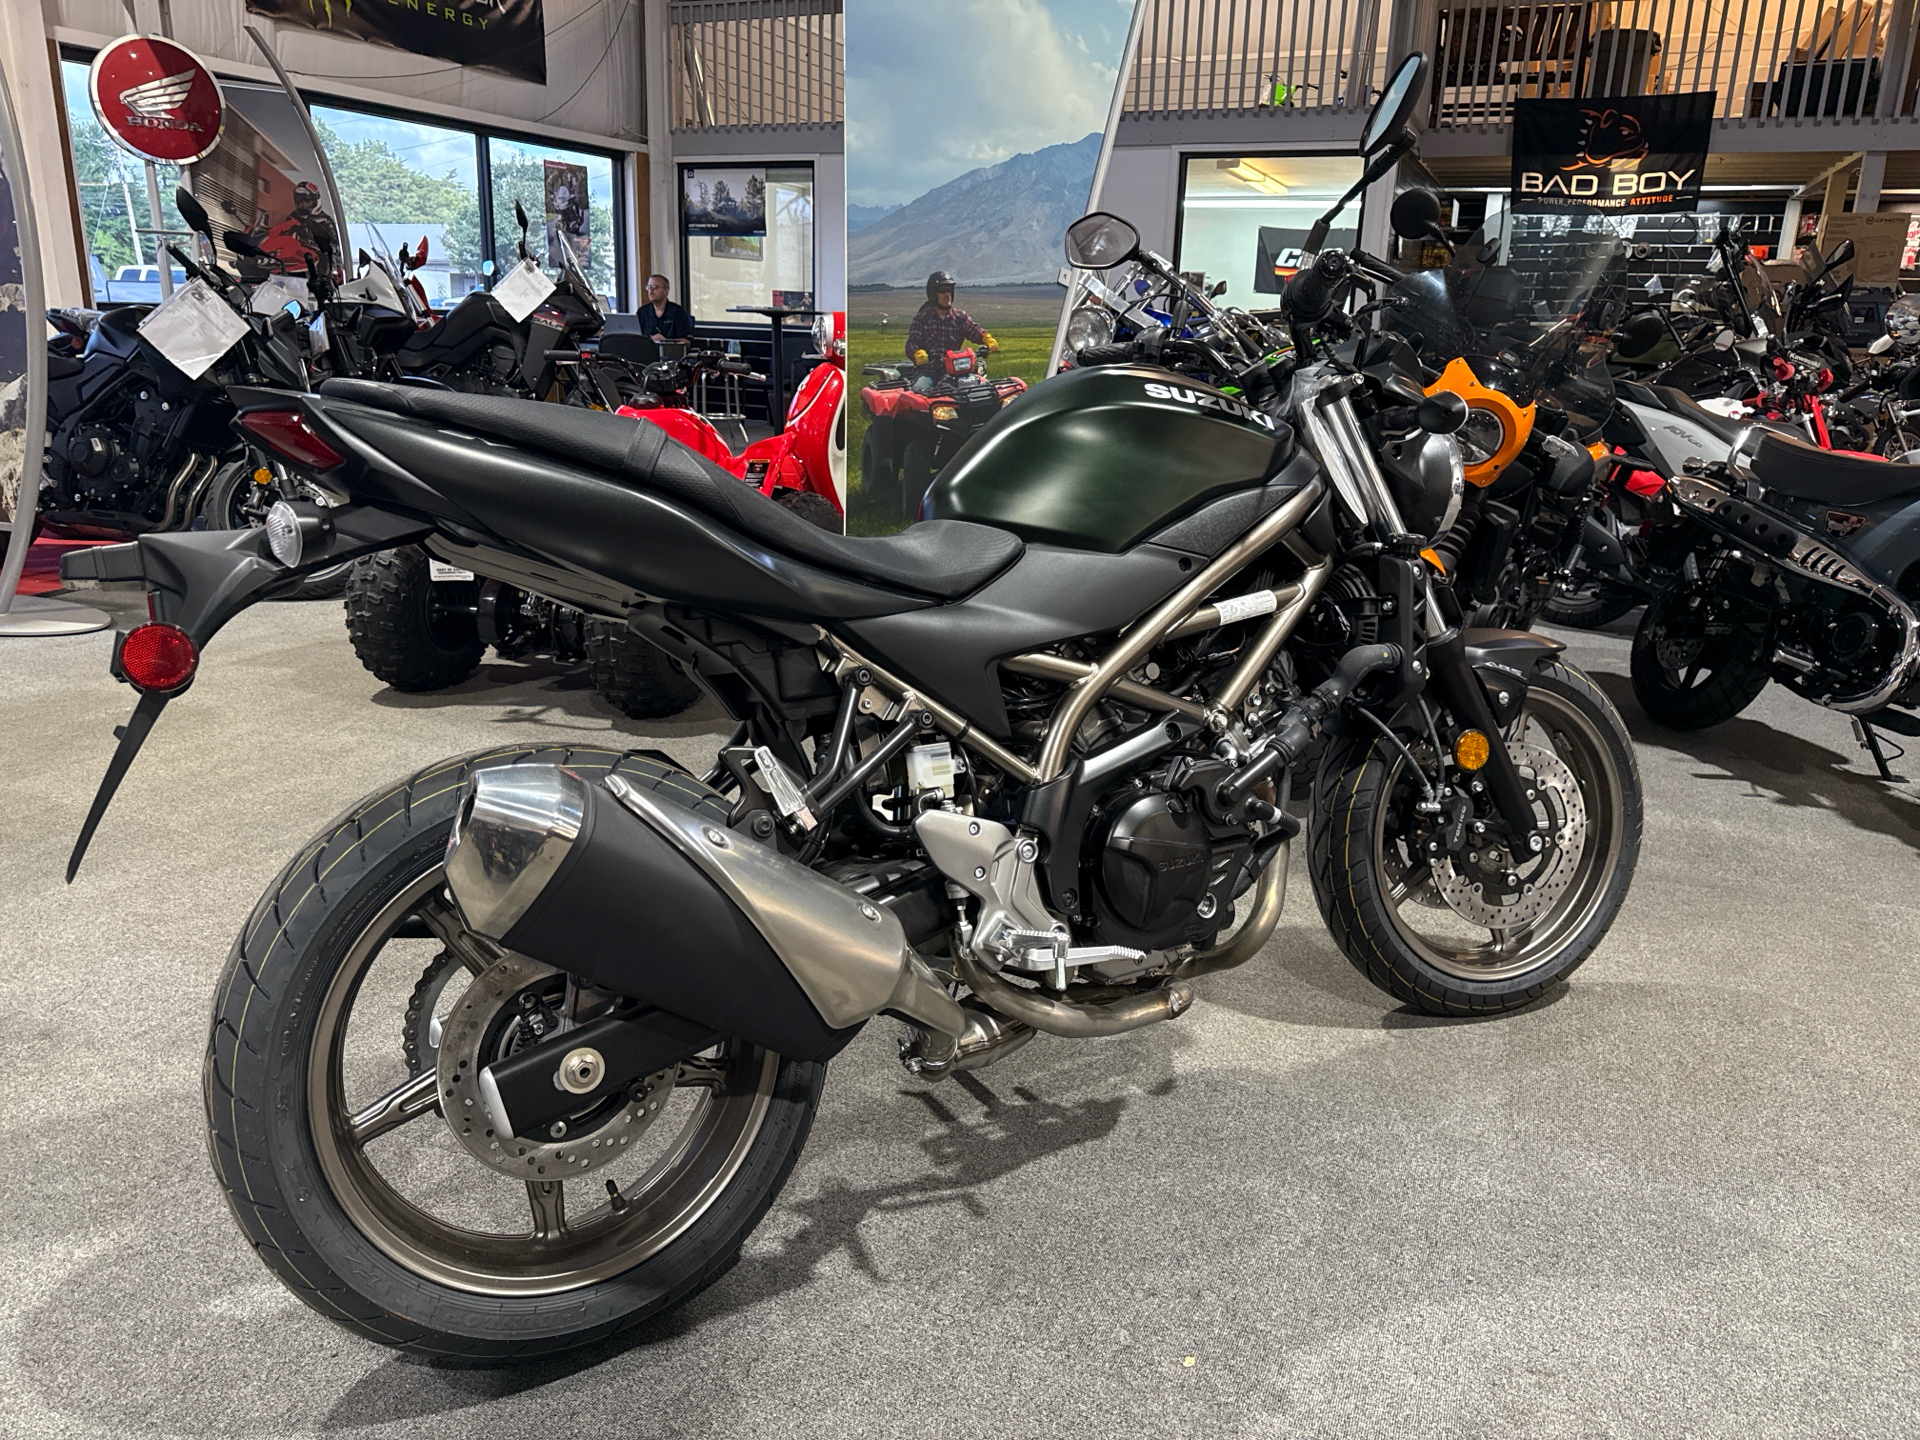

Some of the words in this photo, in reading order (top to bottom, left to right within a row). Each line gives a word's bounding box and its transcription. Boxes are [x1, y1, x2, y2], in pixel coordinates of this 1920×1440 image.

[126, 115, 204, 133] HONDA
[1521, 172, 1598, 195] BAD
[1612, 169, 1696, 195] BOY
[1144, 383, 1275, 431] SUZUKI
[1158, 852, 1206, 872] SUZUKI
